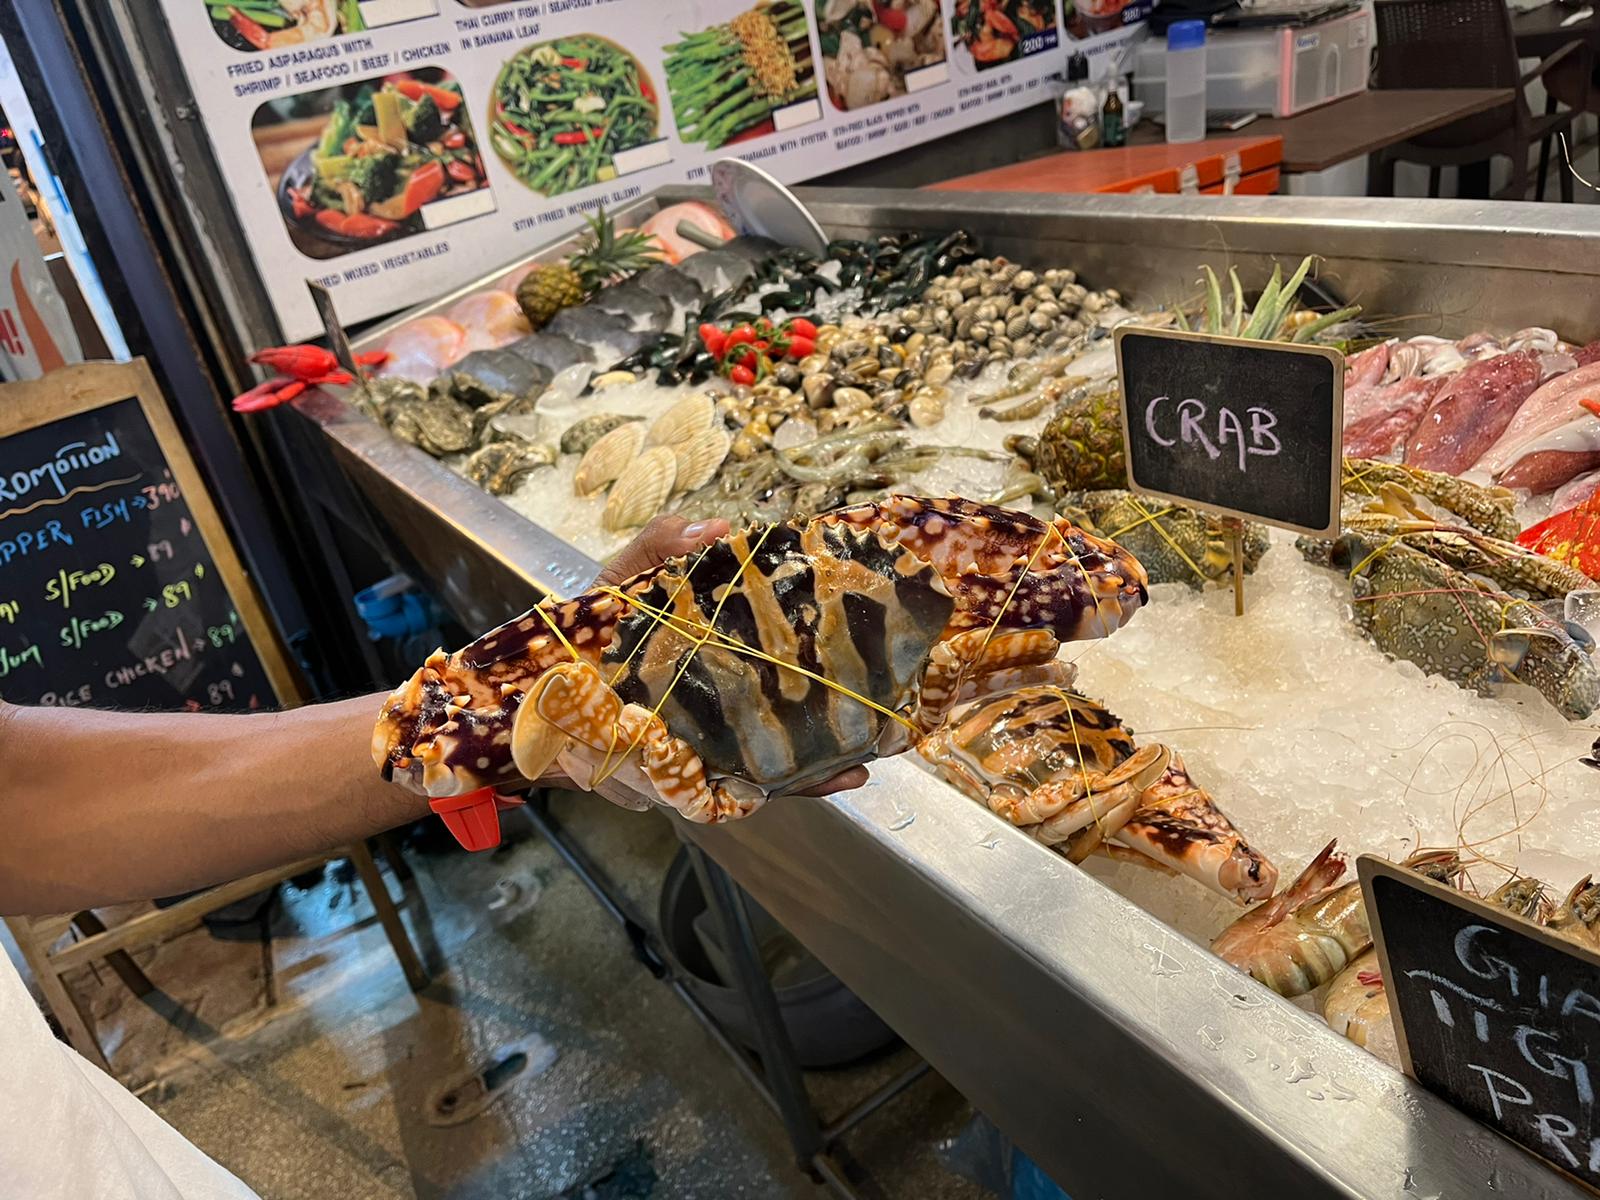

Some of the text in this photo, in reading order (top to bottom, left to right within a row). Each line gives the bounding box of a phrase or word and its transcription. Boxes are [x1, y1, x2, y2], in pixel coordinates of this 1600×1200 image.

[227, 37, 374, 78] FRIED ASPARAGUS WITH
[233, 76, 282, 98] SHRIMP
[294, 62, 351, 84] SEAFOOD
[361, 54, 391, 71] BEEF
[401, 41, 452, 63] CHICKEN
[1145, 396, 1282, 473] CRAB
[0, 519, 74, 566] PPER
[80, 497, 131, 529] FISH
[45, 563, 116, 609] S/FOOD
[60, 610, 124, 649] S/FOOD
[162, 580, 192, 608] 89
[105, 626, 191, 689] CHICKEN
[207, 623, 236, 648] 89
